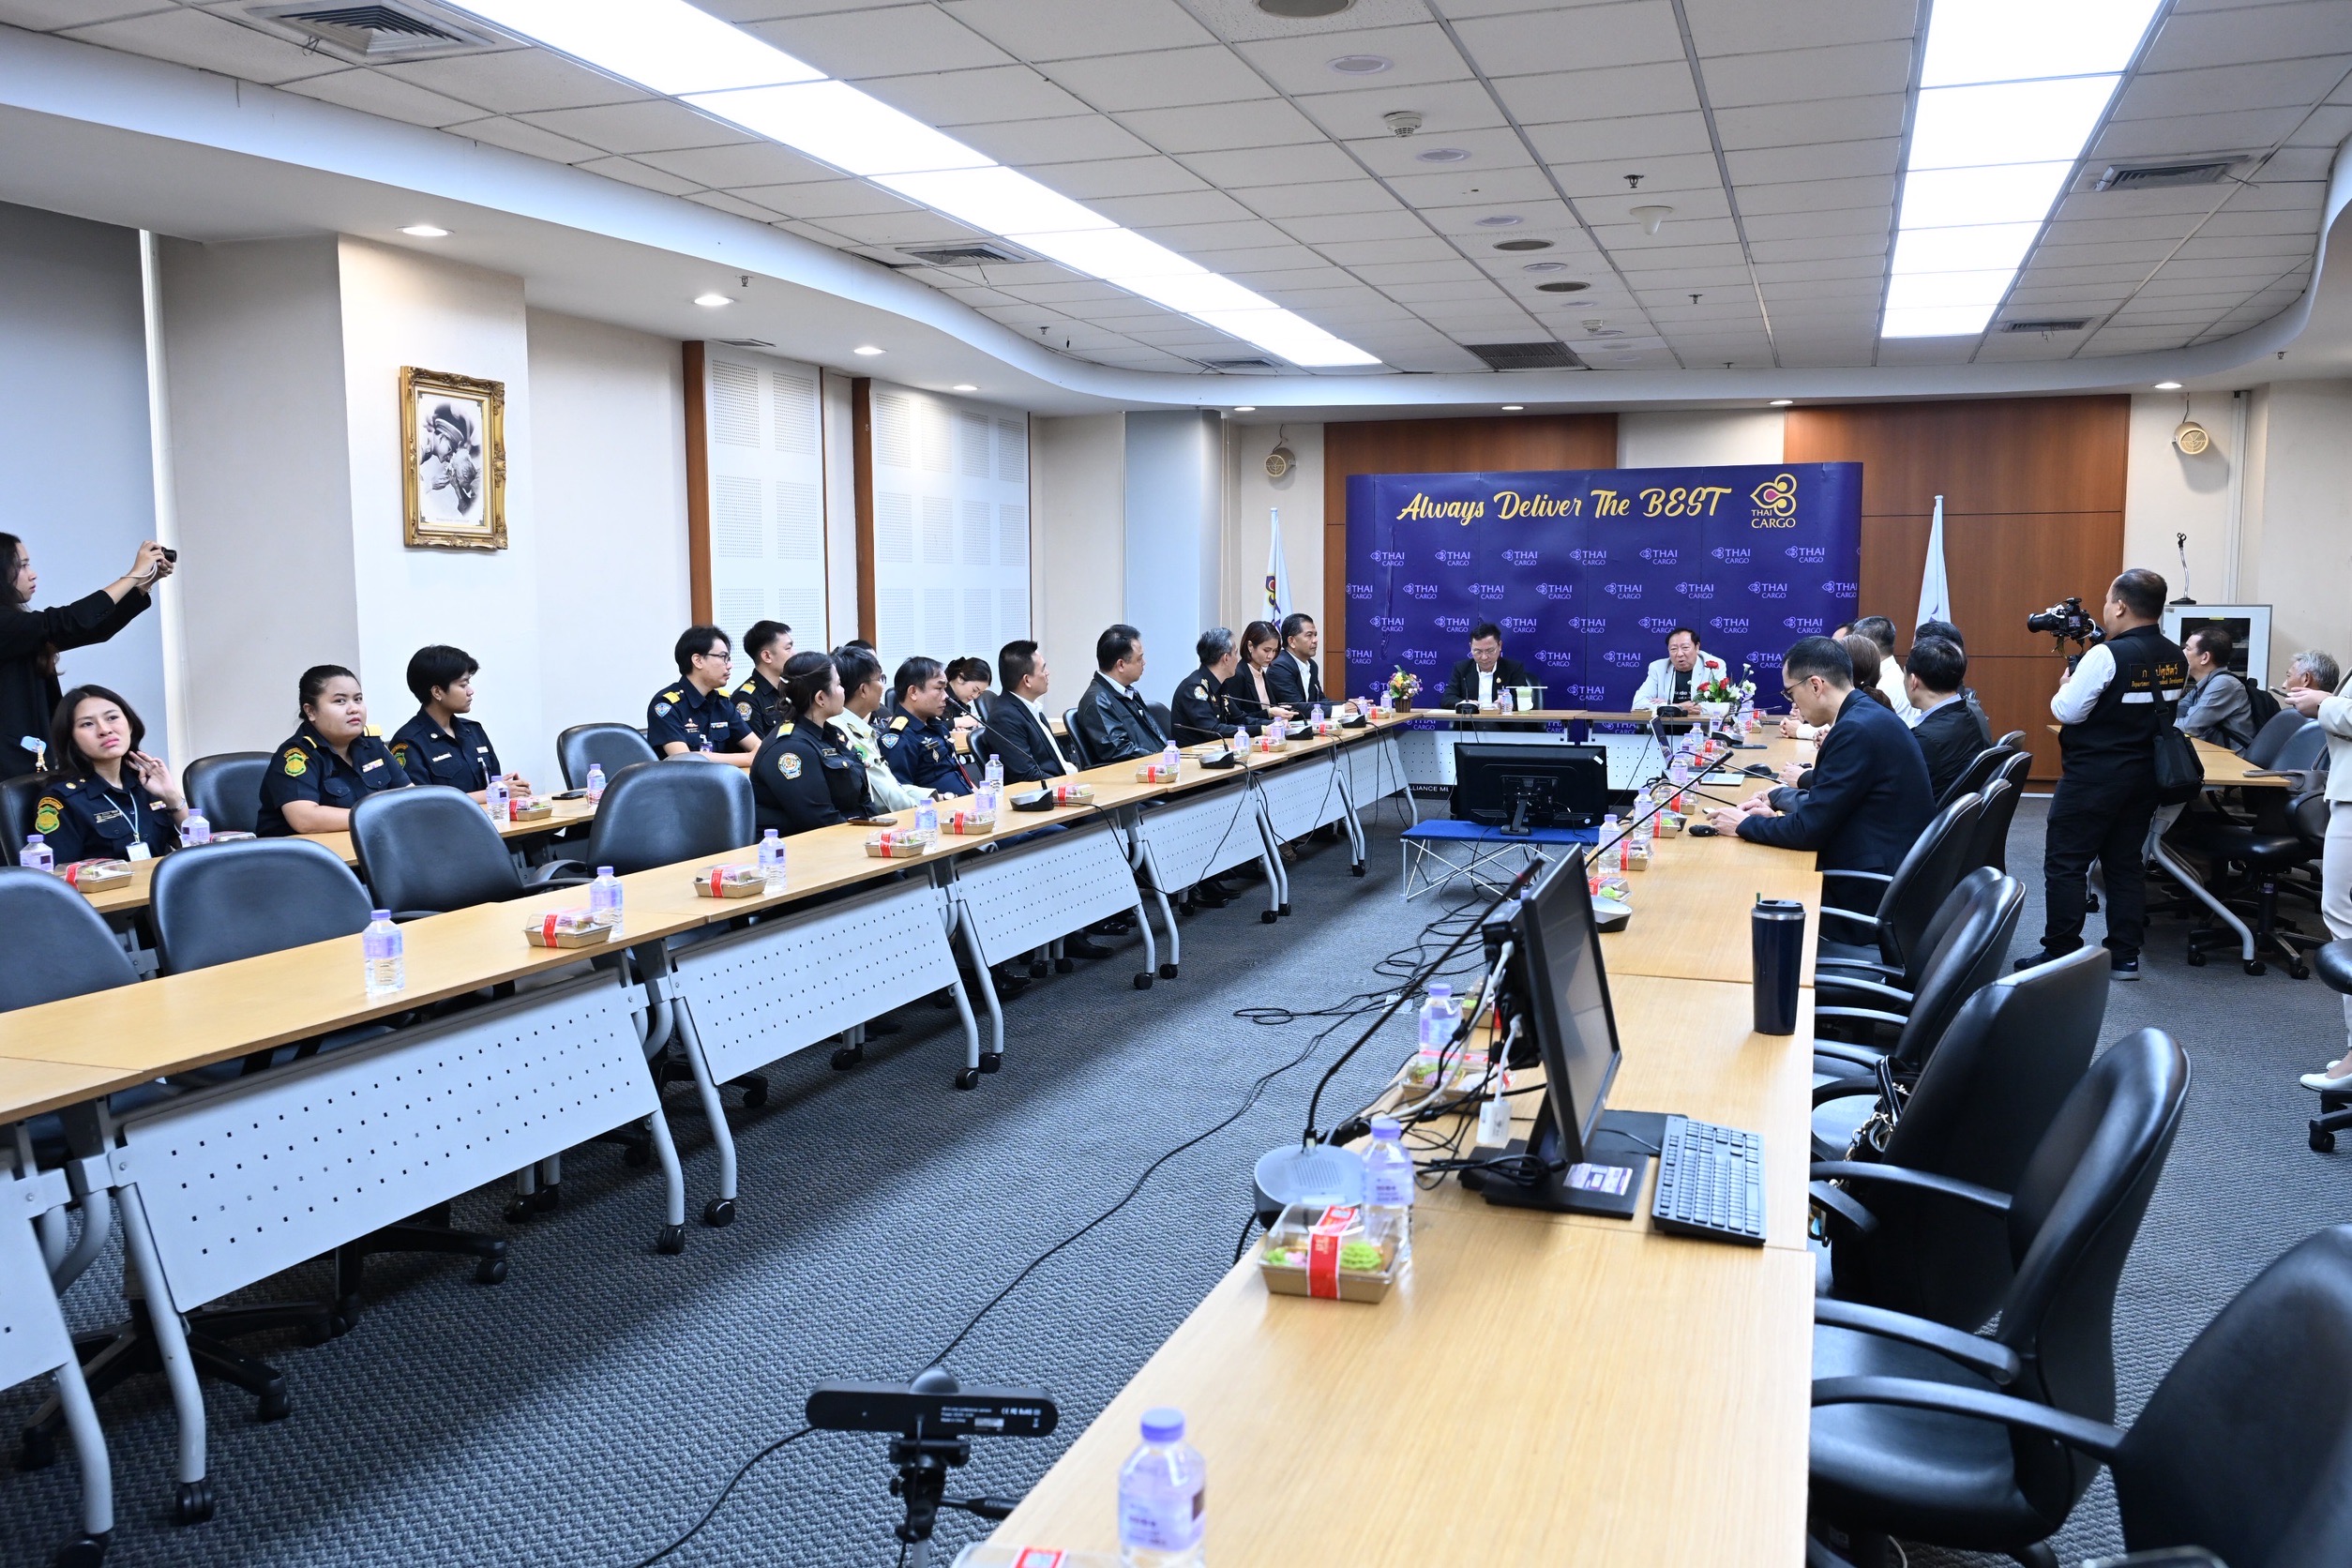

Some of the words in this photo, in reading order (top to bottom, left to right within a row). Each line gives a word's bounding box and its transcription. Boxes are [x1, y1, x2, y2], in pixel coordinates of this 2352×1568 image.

[1396, 492, 1485, 526] Always
[1493, 490, 1581, 520] Deliver
[1591, 490, 1630, 518] The
[1639, 487, 1732, 518] BEST
[1751, 518, 1796, 529] CARGO
[1382, 551, 1405, 560] THAI
[1447, 551, 1470, 560] THAI
[1515, 551, 1538, 560] THAI
[1582, 550, 1606, 560] THAI
[1799, 548, 1825, 556] THAI
[1762, 583, 1787, 592] THAI
